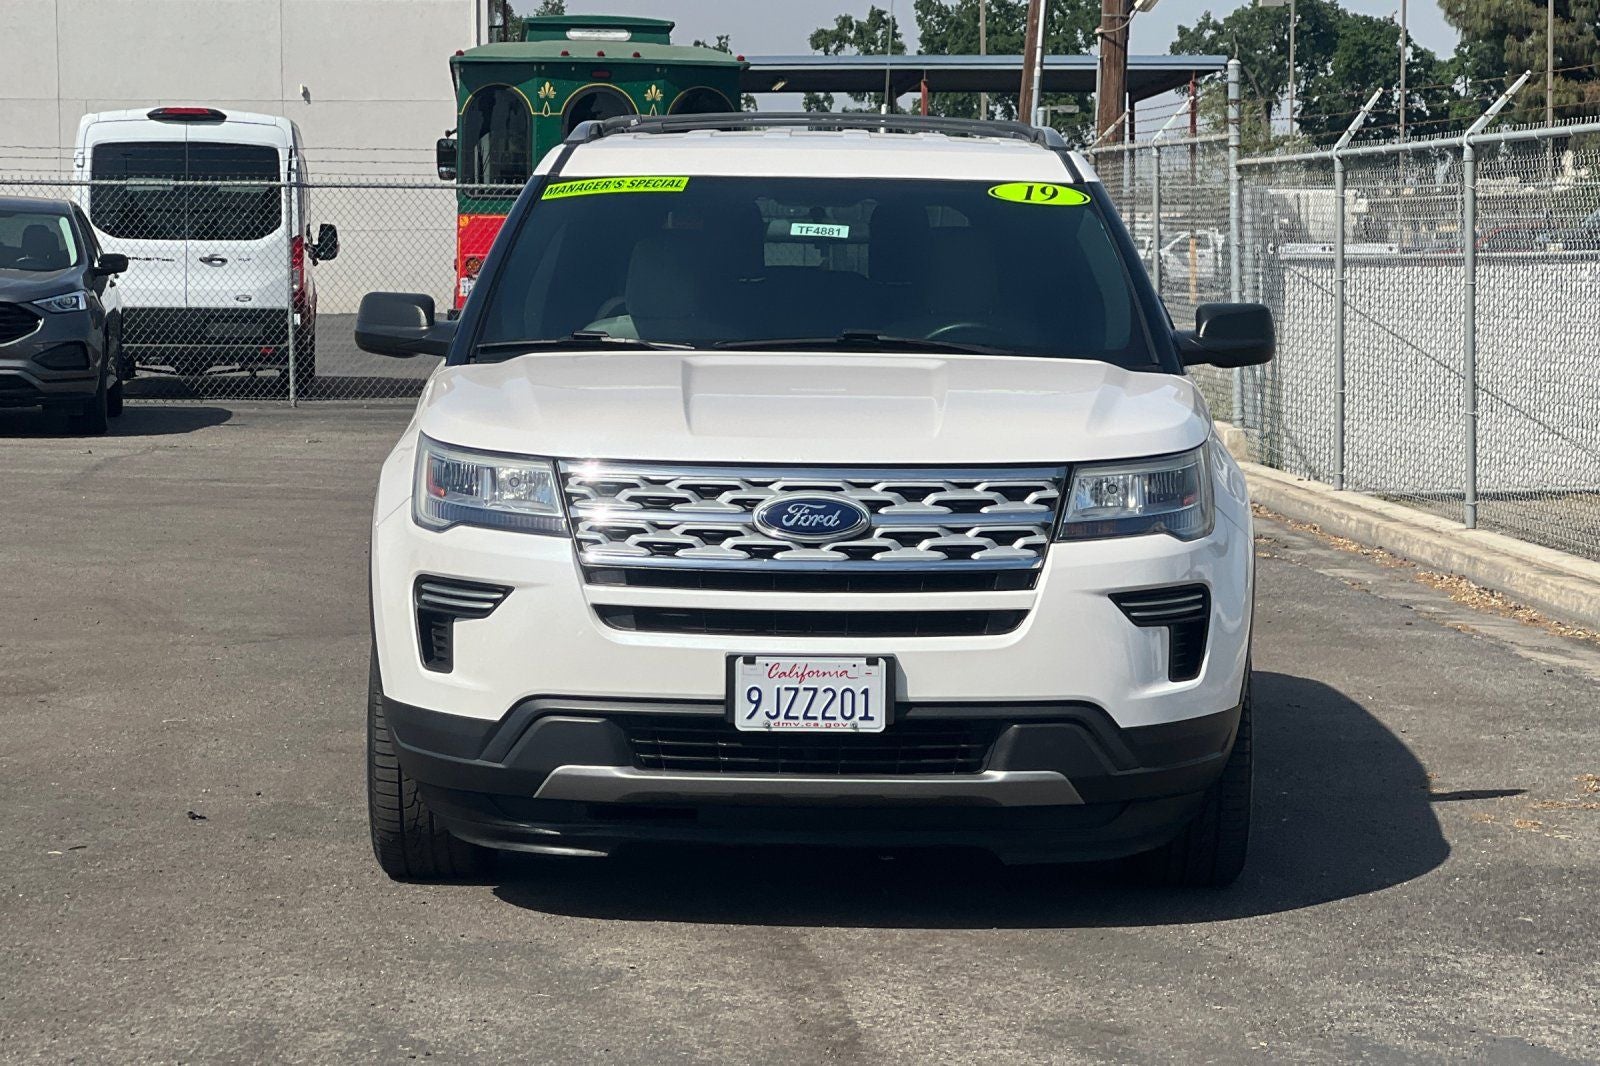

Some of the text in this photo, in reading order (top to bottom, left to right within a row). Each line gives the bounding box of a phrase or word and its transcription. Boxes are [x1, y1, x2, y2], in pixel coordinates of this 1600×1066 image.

[545, 178, 685, 196] MANAGER'S SPECIAL
[1023, 185, 1059, 201] 19
[797, 226, 841, 236] TF4881
[782, 503, 841, 527] Ford
[767, 662, 858, 684] California
[746, 686, 875, 721] 9JZZ201
[773, 721, 848, 729] dmv.ca.gov
